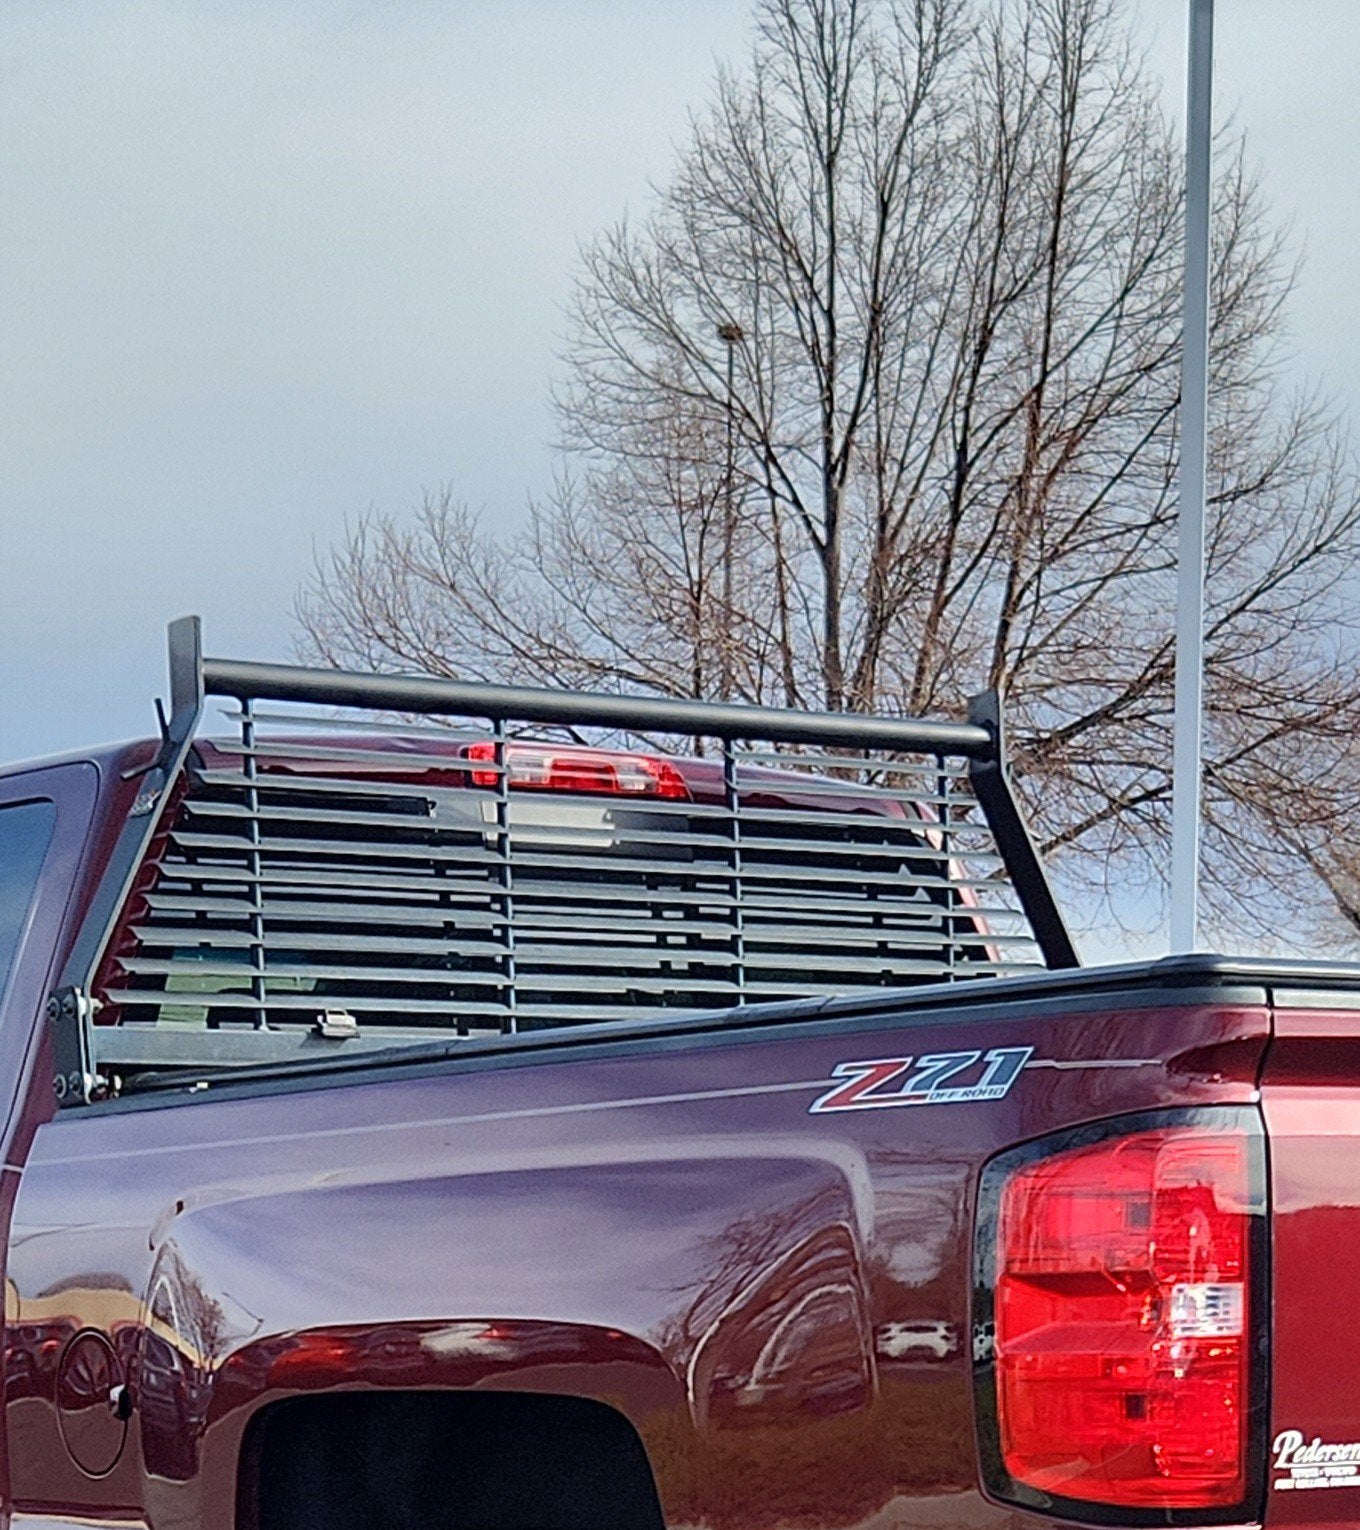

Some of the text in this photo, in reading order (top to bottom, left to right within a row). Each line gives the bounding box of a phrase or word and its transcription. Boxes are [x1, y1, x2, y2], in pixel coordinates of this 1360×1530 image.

[808, 1045, 1035, 1114] Z71
[928, 1086, 1005, 1101] OFF ROAD
